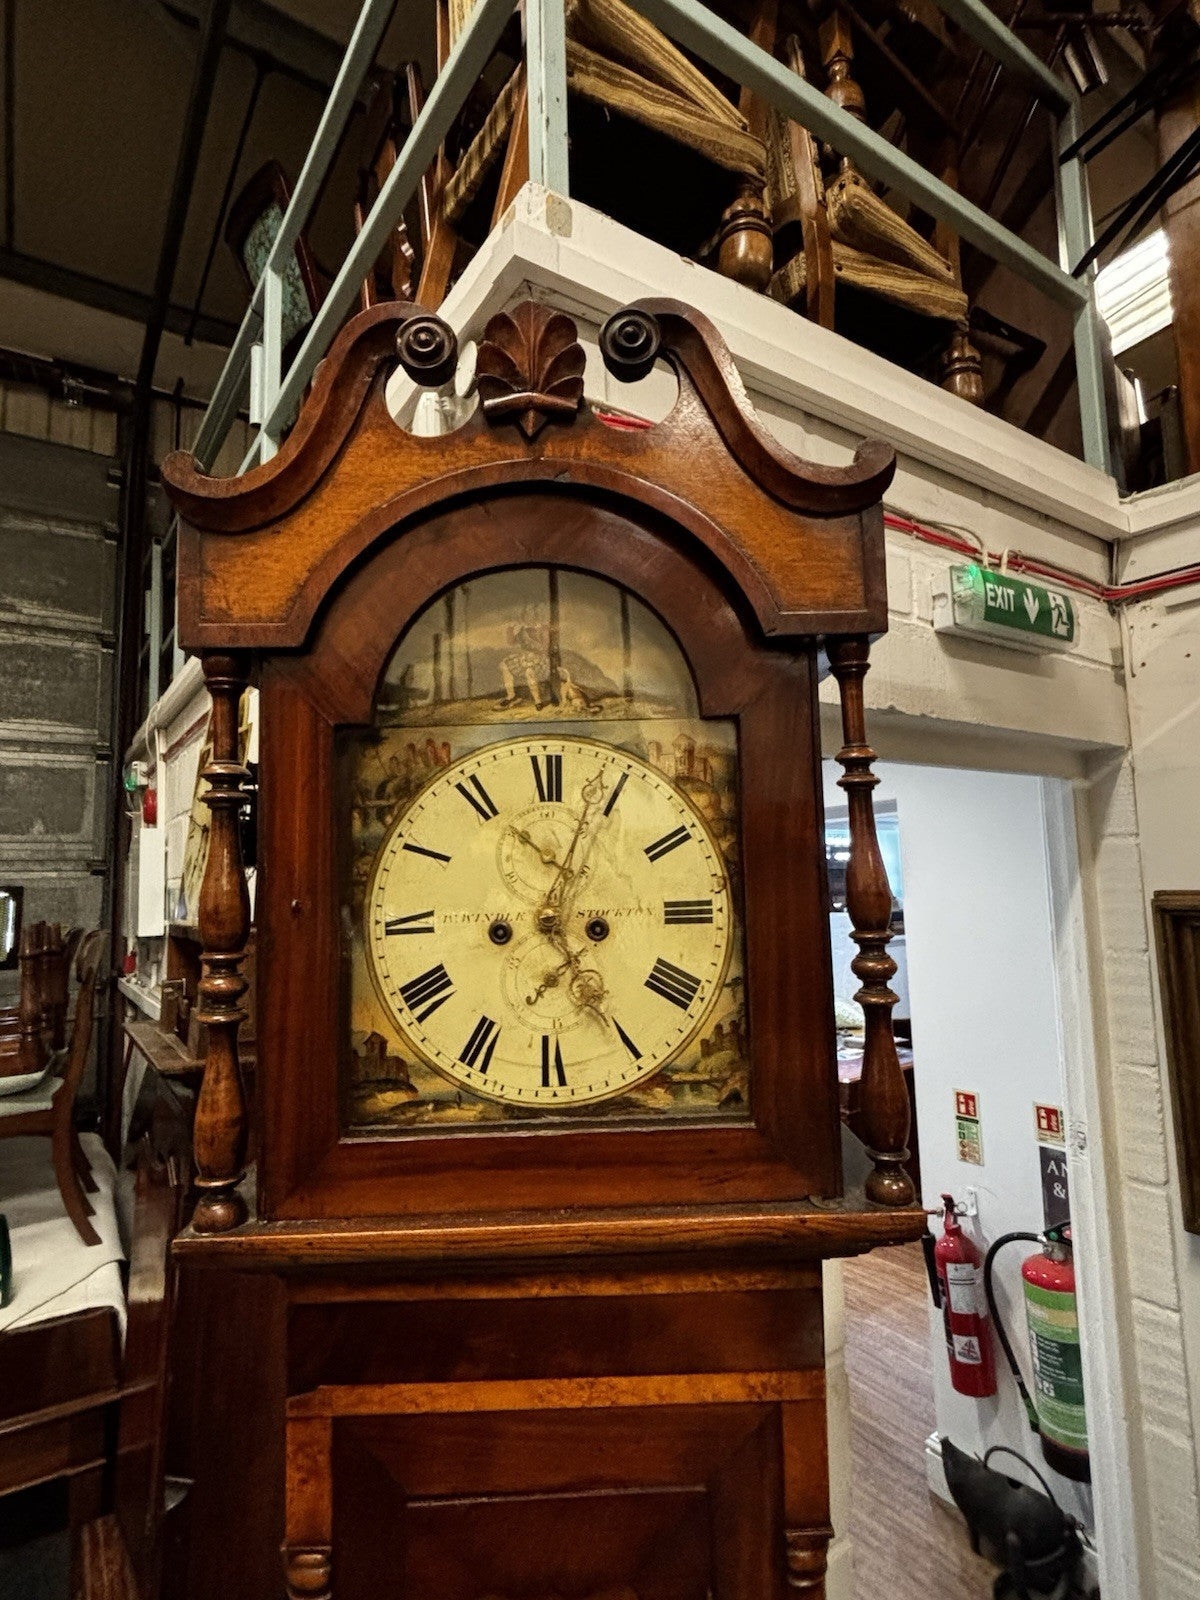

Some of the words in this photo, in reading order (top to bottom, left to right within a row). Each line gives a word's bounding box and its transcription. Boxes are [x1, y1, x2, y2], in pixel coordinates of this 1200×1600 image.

[985, 583, 1015, 612] EXIT
[644, 824, 693, 863] II
[663, 899, 714, 925] III
